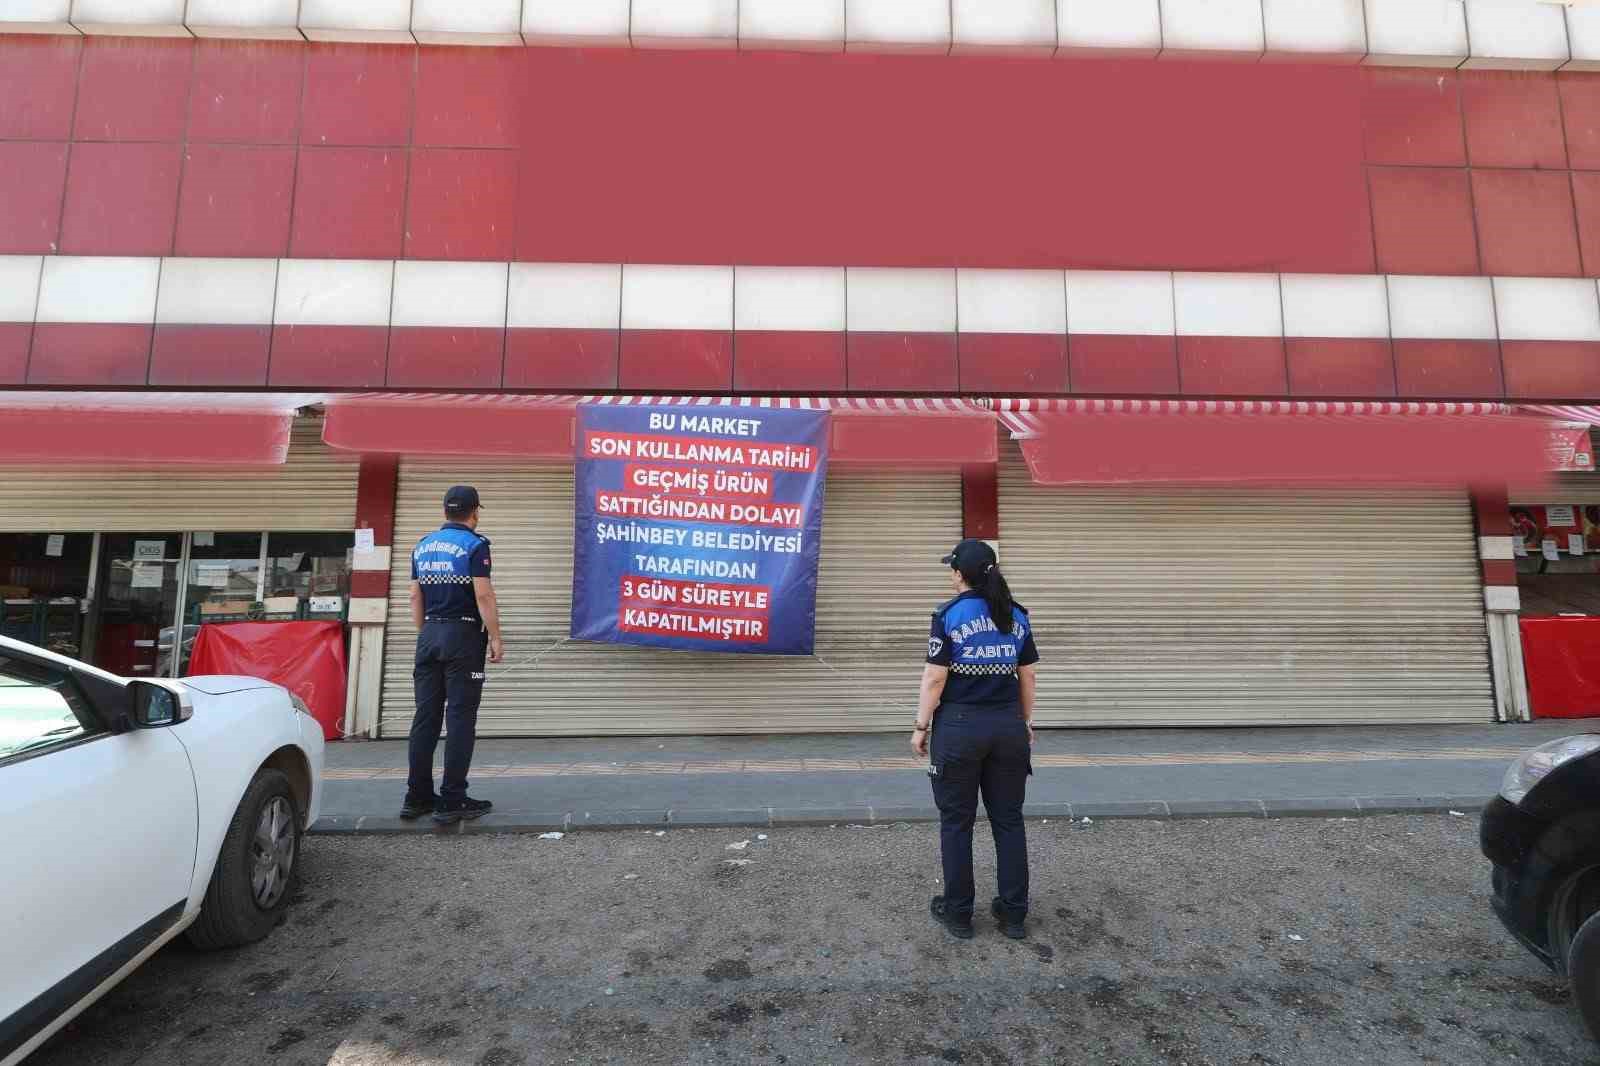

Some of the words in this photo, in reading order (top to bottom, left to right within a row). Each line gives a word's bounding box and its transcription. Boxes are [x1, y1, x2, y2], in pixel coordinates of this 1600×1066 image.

[649, 412, 676, 431] BU
[680, 415, 762, 436] MARKET
[590, 437, 631, 457] SON
[636, 440, 745, 464] KULLANMA
[748, 446, 811, 469] TARİHİ
[633, 467, 709, 496] GEÇMİŞ
[713, 471, 768, 494] ÜRÜN
[599, 493, 725, 520] SATTIĞINDAN
[730, 504, 801, 526] DOLAYI
[596, 521, 688, 546] ŞAHİNBEY
[691, 529, 802, 553] BELEDİYESİ
[635, 554, 756, 580] TARAFINDAN
[623, 581, 634, 597] 3
[637, 580, 677, 602] GÜN
[681, 583, 768, 609] SÜREYLE
[624, 608, 763, 639] KAPATILMIŞTIR
